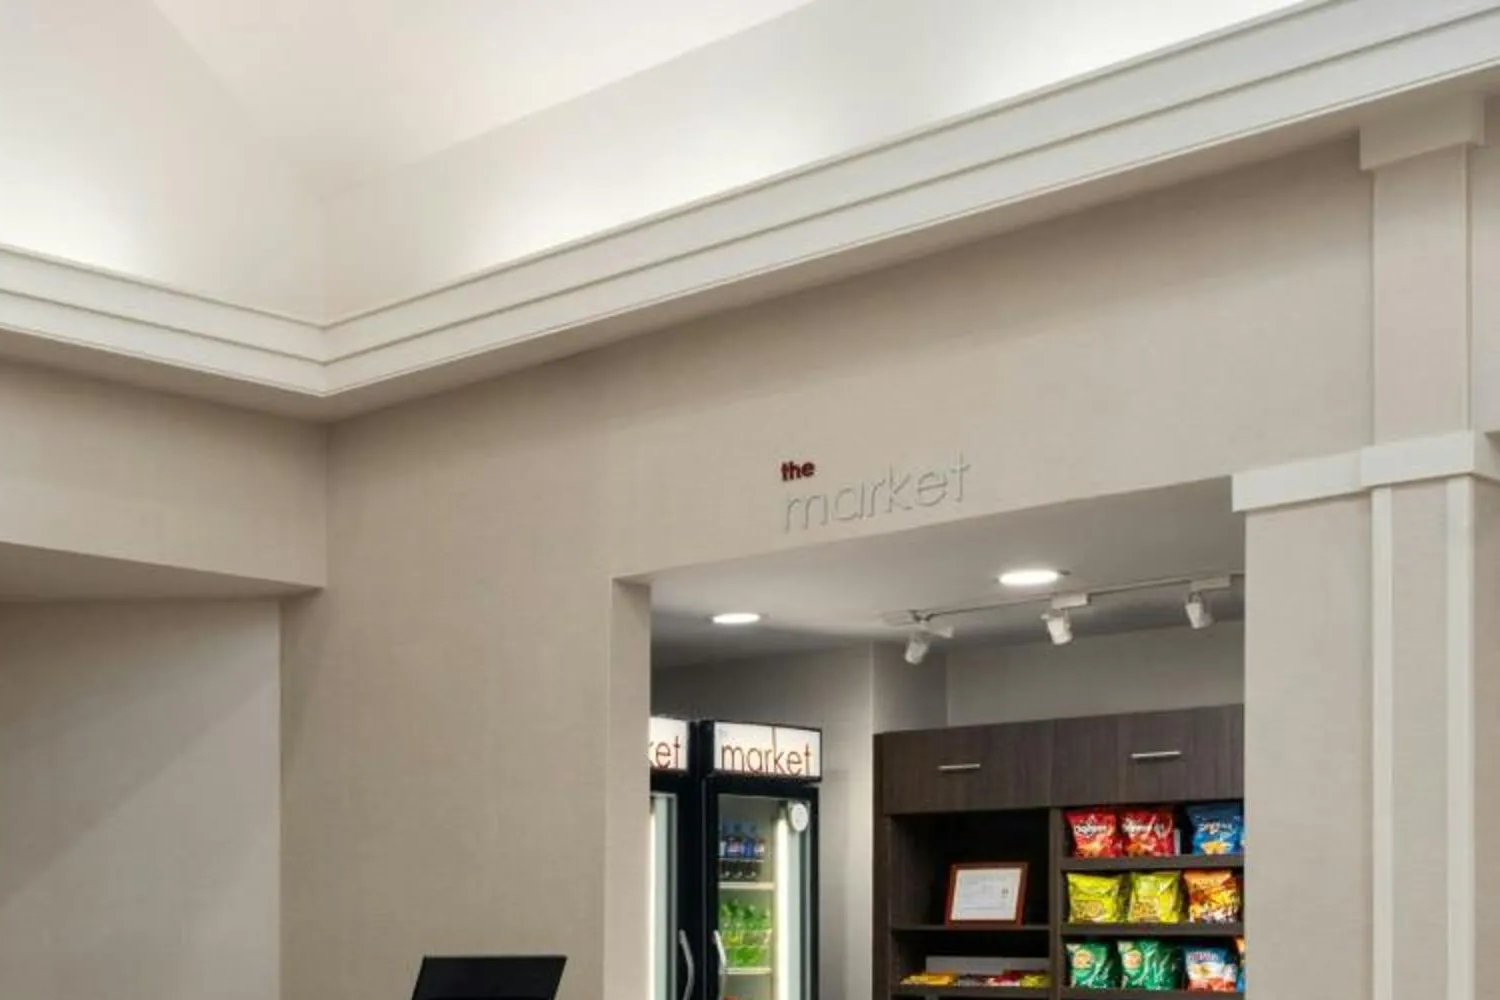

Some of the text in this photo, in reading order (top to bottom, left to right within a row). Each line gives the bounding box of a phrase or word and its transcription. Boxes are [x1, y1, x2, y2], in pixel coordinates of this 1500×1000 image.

[781, 461, 815, 482] the
[784, 453, 971, 534] market
[721, 743, 812, 777] market
